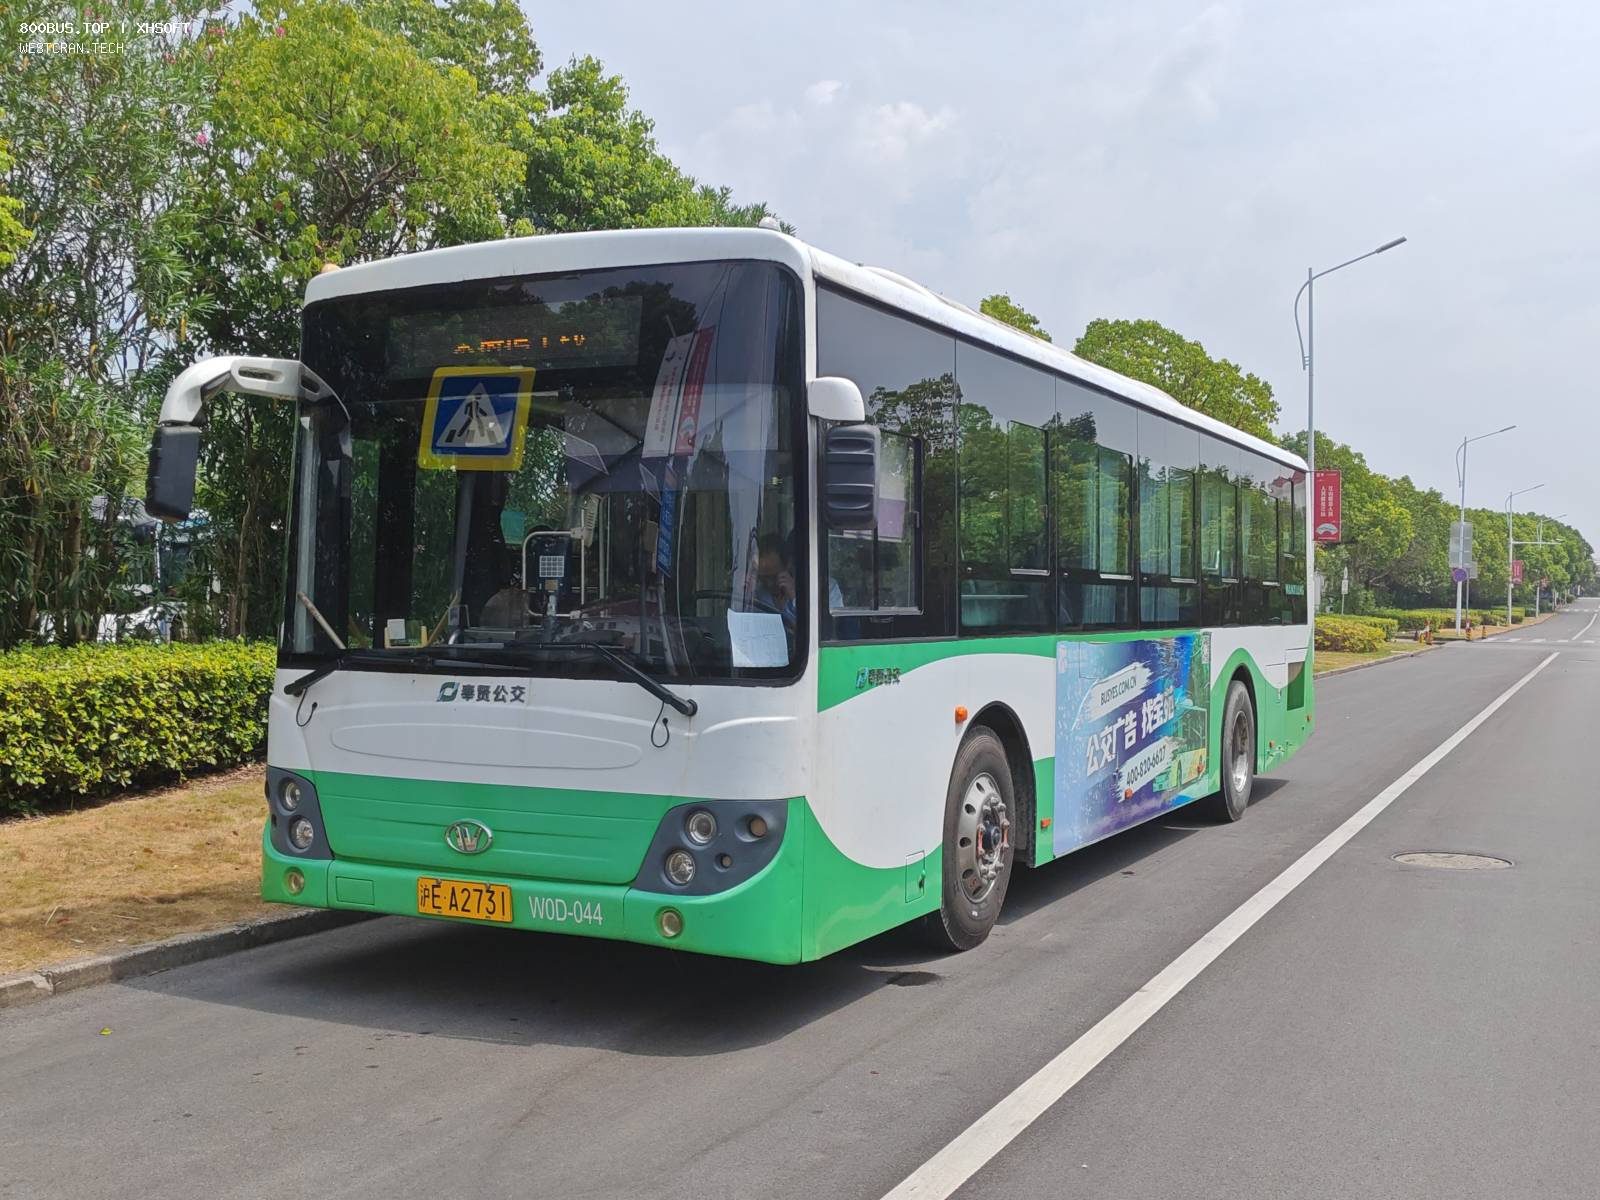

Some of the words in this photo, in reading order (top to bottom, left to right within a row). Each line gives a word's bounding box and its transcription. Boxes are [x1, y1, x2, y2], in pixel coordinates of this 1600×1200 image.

[460, 684, 526, 703] 奉贤公交
[1086, 709, 1137, 777] 公交广告
[1126, 745, 1167, 786] 400-820-6627
